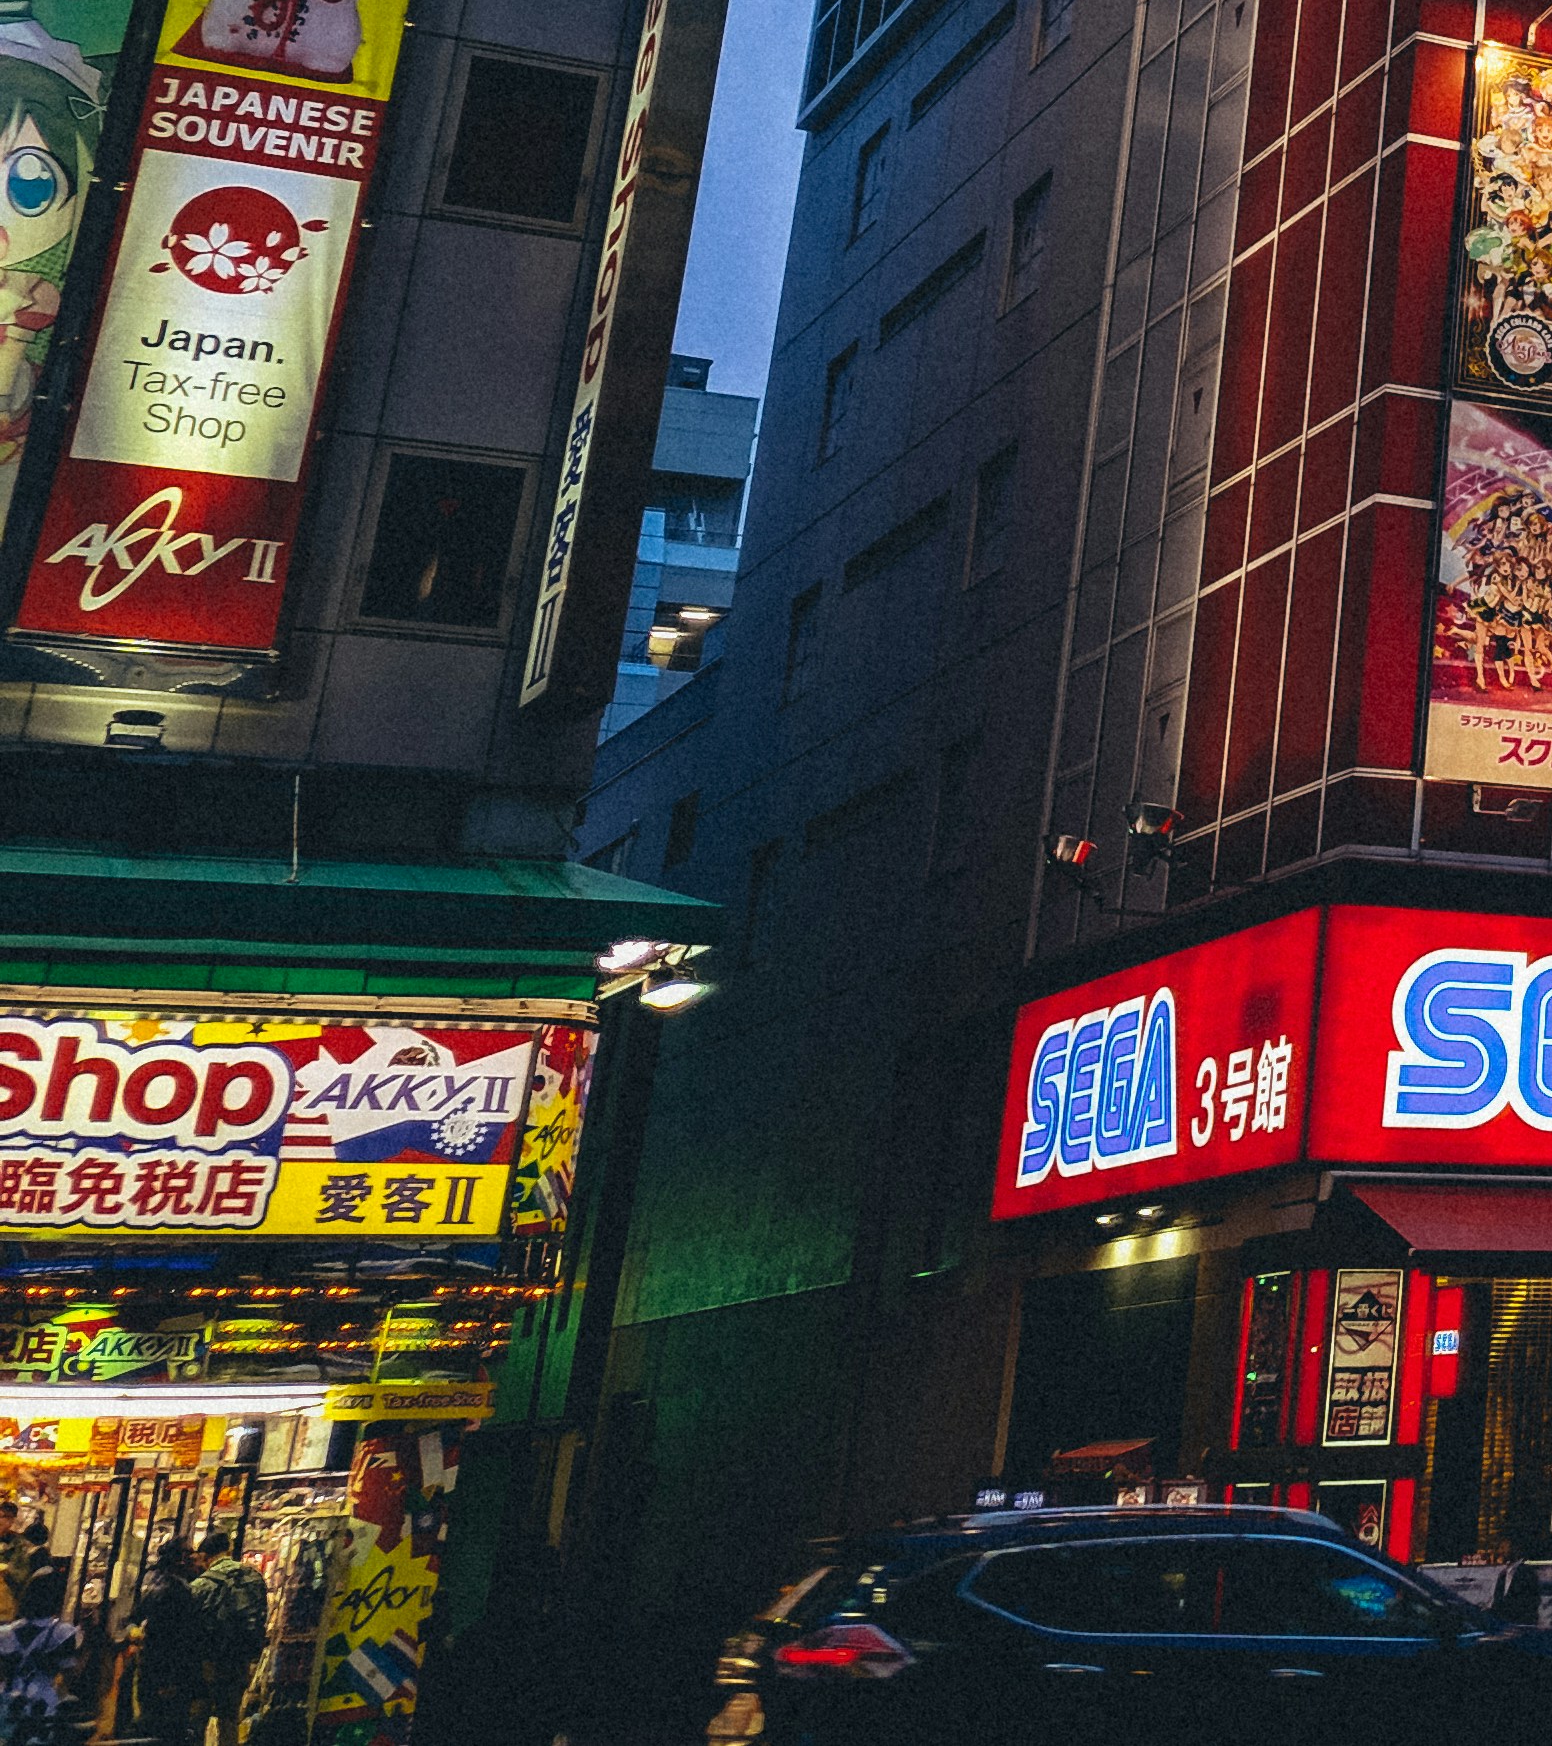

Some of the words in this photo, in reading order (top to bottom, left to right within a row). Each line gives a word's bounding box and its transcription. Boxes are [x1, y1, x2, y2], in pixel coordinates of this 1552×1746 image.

[153, 77, 377, 138] JAPANESE
[147, 111, 365, 171] SOUVENIR
[140, 319, 286, 366] Japan.
[122, 359, 288, 411] Tax-free
[142, 402, 247, 449] Shop
[0, 1032, 276, 1138] Shop
[1016, 985, 1179, 1188] SEGA
[1190, 1034, 1292, 1148] 3号館
